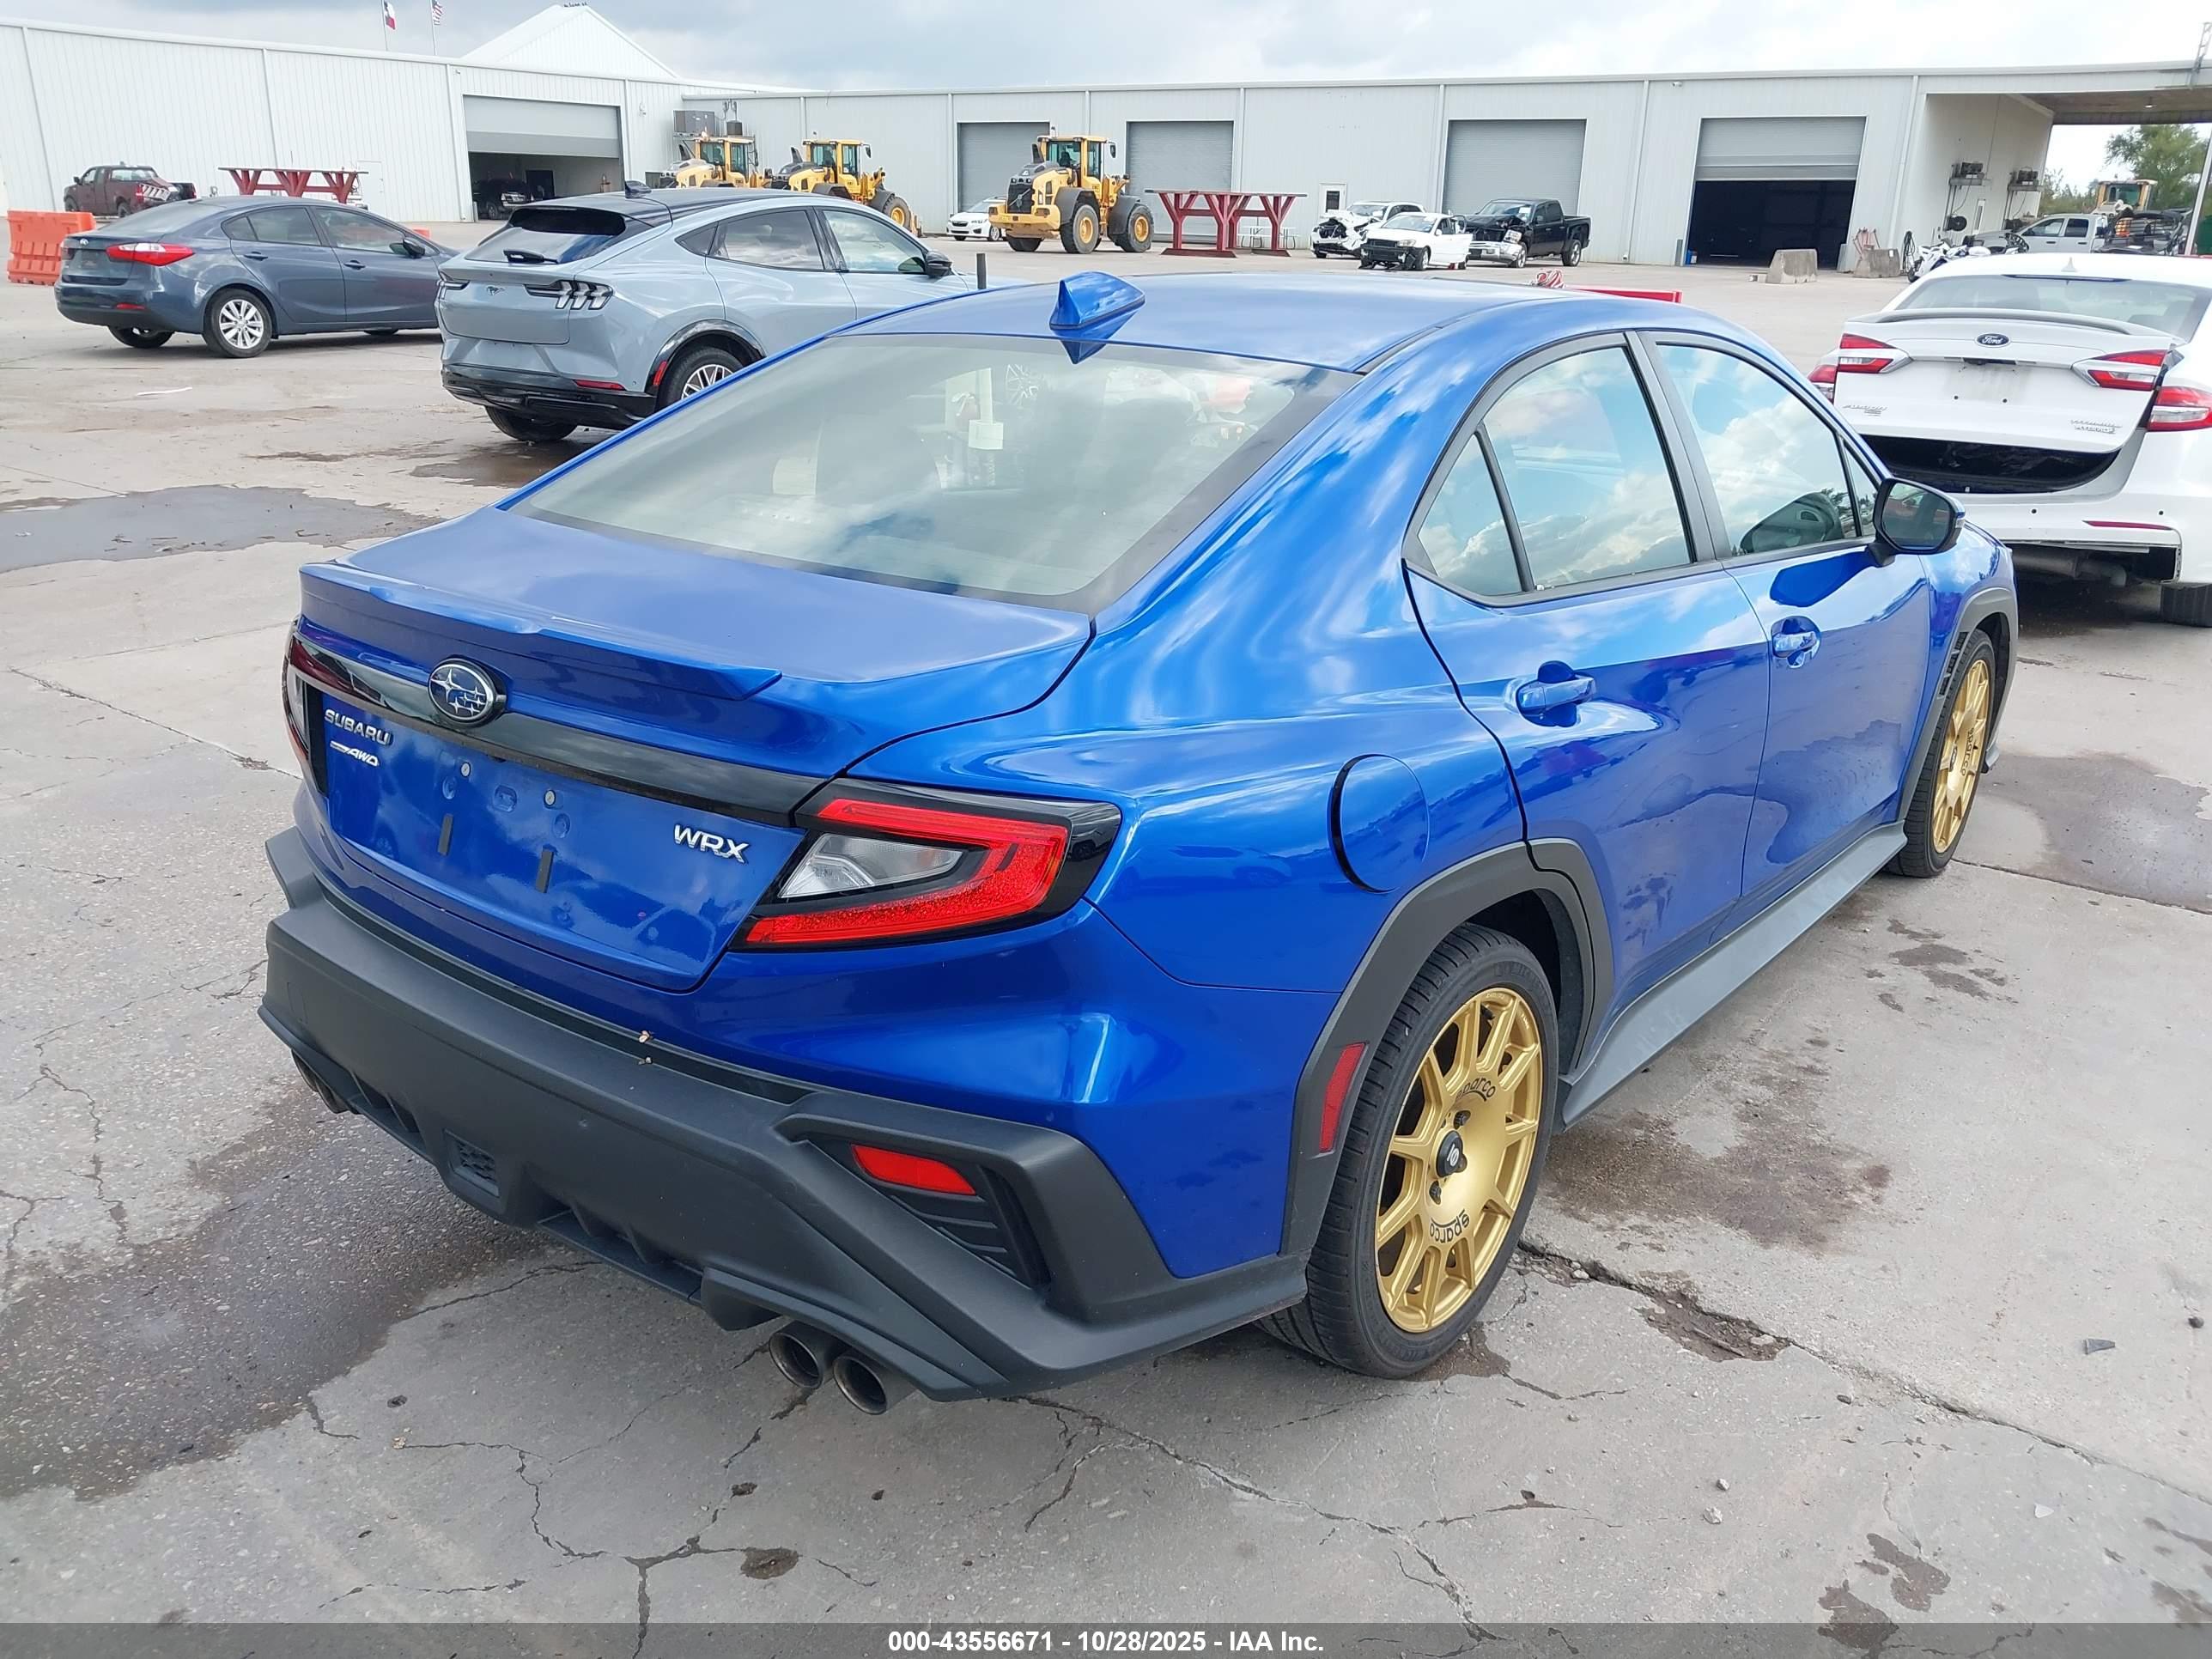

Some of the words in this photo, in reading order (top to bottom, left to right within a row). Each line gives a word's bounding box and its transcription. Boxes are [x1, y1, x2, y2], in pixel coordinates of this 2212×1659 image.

[1982, 335, 2003, 344] Ford
[324, 708, 392, 745] SUBARU
[674, 823, 749, 863] WRX
[1430, 1211, 1470, 1243] sparco
